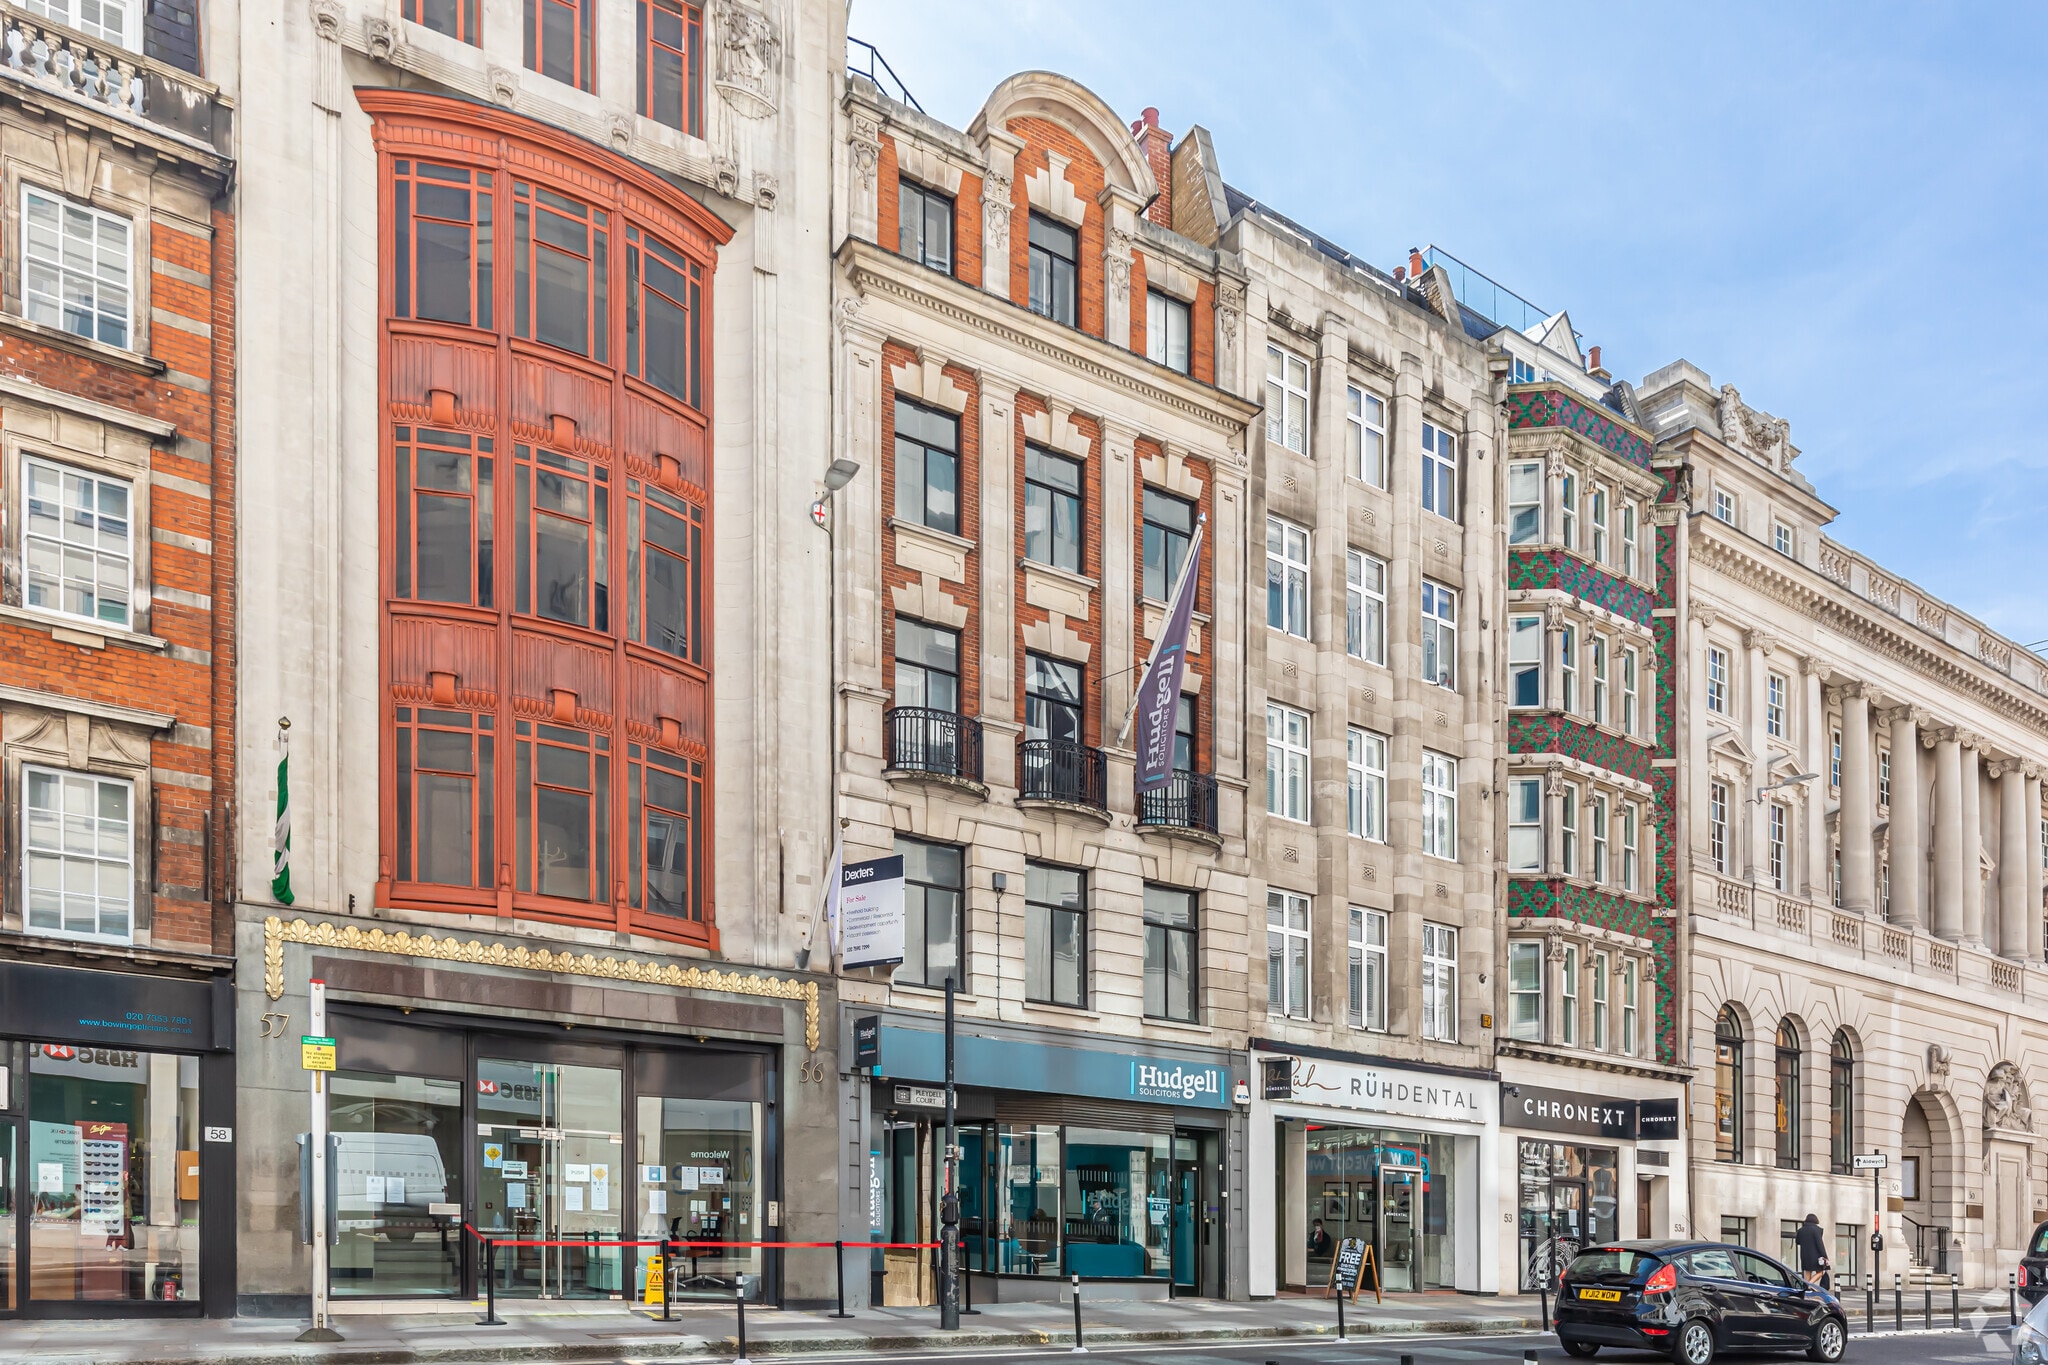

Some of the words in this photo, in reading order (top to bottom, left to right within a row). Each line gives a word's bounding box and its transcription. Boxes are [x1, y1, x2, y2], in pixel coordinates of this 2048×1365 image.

[1145, 656, 1175, 771] Hudgell
[1158, 708, 1170, 767] SOLICITORS
[845, 867, 874, 881] Dexters
[846, 896, 855, 904] For
[856, 894, 867, 903] Sale
[125, 1011, 143, 1021] 020
[146, 1013, 168, 1023] 7353
[259, 1012, 290, 1038] 57
[799, 1060, 824, 1083] 56
[1138, 1064, 1219, 1100] Hudgell
[915, 1089, 942, 1098] PLEYDELL
[1139, 1087, 1181, 1099] SOLICITORS
[1350, 1072, 1478, 1110] RÜHDENTAL
[915, 1096, 936, 1105] COURT
[1523, 1098, 1625, 1127] CHRONEXT
[210, 1129, 227, 1140] 58
[1891, 1183, 1899, 1192] 50
[1968, 1191, 1976, 1199] 50
[1503, 1213, 1513, 1223] 53
[1674, 1223, 1685, 1233] 53a
[1338, 1251, 1362, 1265] FREE
[1585, 1290, 1600, 1298] YJ12
